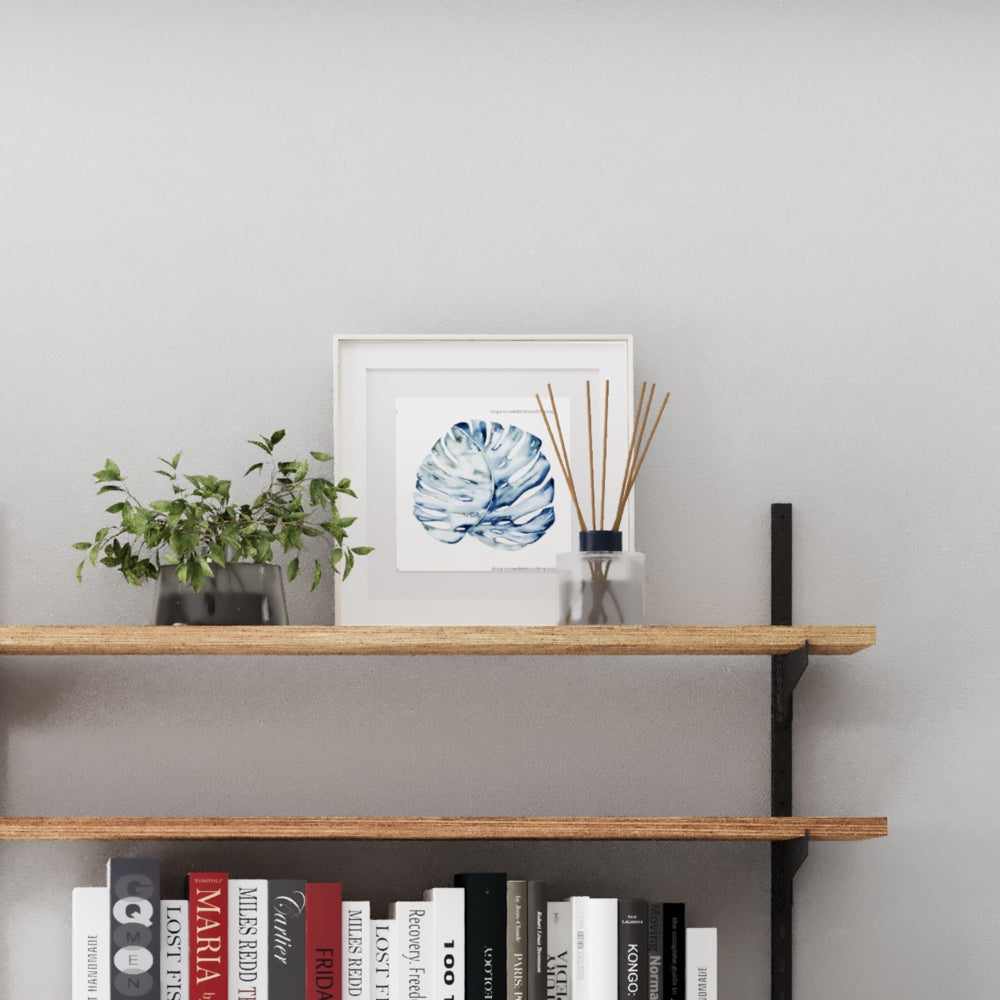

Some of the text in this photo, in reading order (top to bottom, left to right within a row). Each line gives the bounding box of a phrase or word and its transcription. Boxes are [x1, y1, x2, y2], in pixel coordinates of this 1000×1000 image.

[167, 907, 181, 962] LOST
[196, 888, 221, 985] MARIA
[239, 888, 257, 936] MILES
[273, 890, 305, 965] Cartier
[348, 910, 362, 960] MILES
[650, 904, 661, 951] Moving
[88, 934, 98, 992] HANDMADE
[239, 939, 257, 982] REDD
[375, 926, 389, 978] LOST
[444, 940, 454, 985] 100
[628, 944, 638, 995] KONGO:
[348, 961, 362, 996] REDD
[671, 987, 678, 995] to
